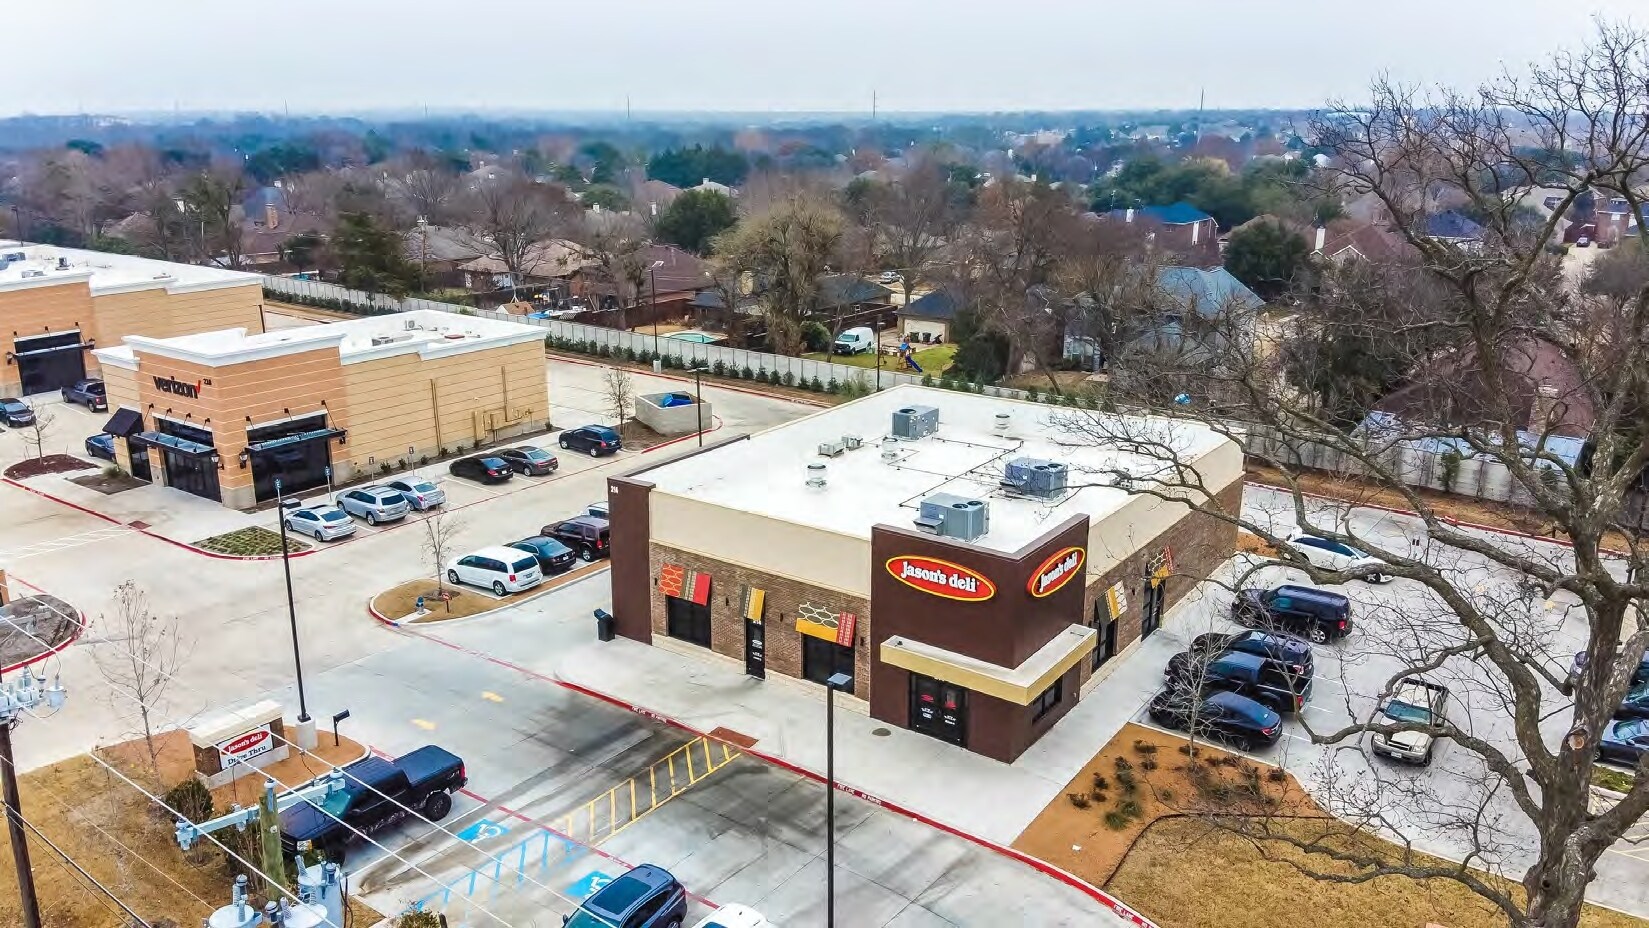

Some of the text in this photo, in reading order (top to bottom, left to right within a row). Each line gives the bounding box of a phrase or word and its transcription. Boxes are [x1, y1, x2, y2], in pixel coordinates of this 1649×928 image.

[153, 376, 198, 399] verizon
[1063, 551, 1078, 572] deli
[901, 561, 977, 593] Jason's deli
[228, 732, 263, 753] Jason's deli
[227, 745, 266, 765] Drve Thru
